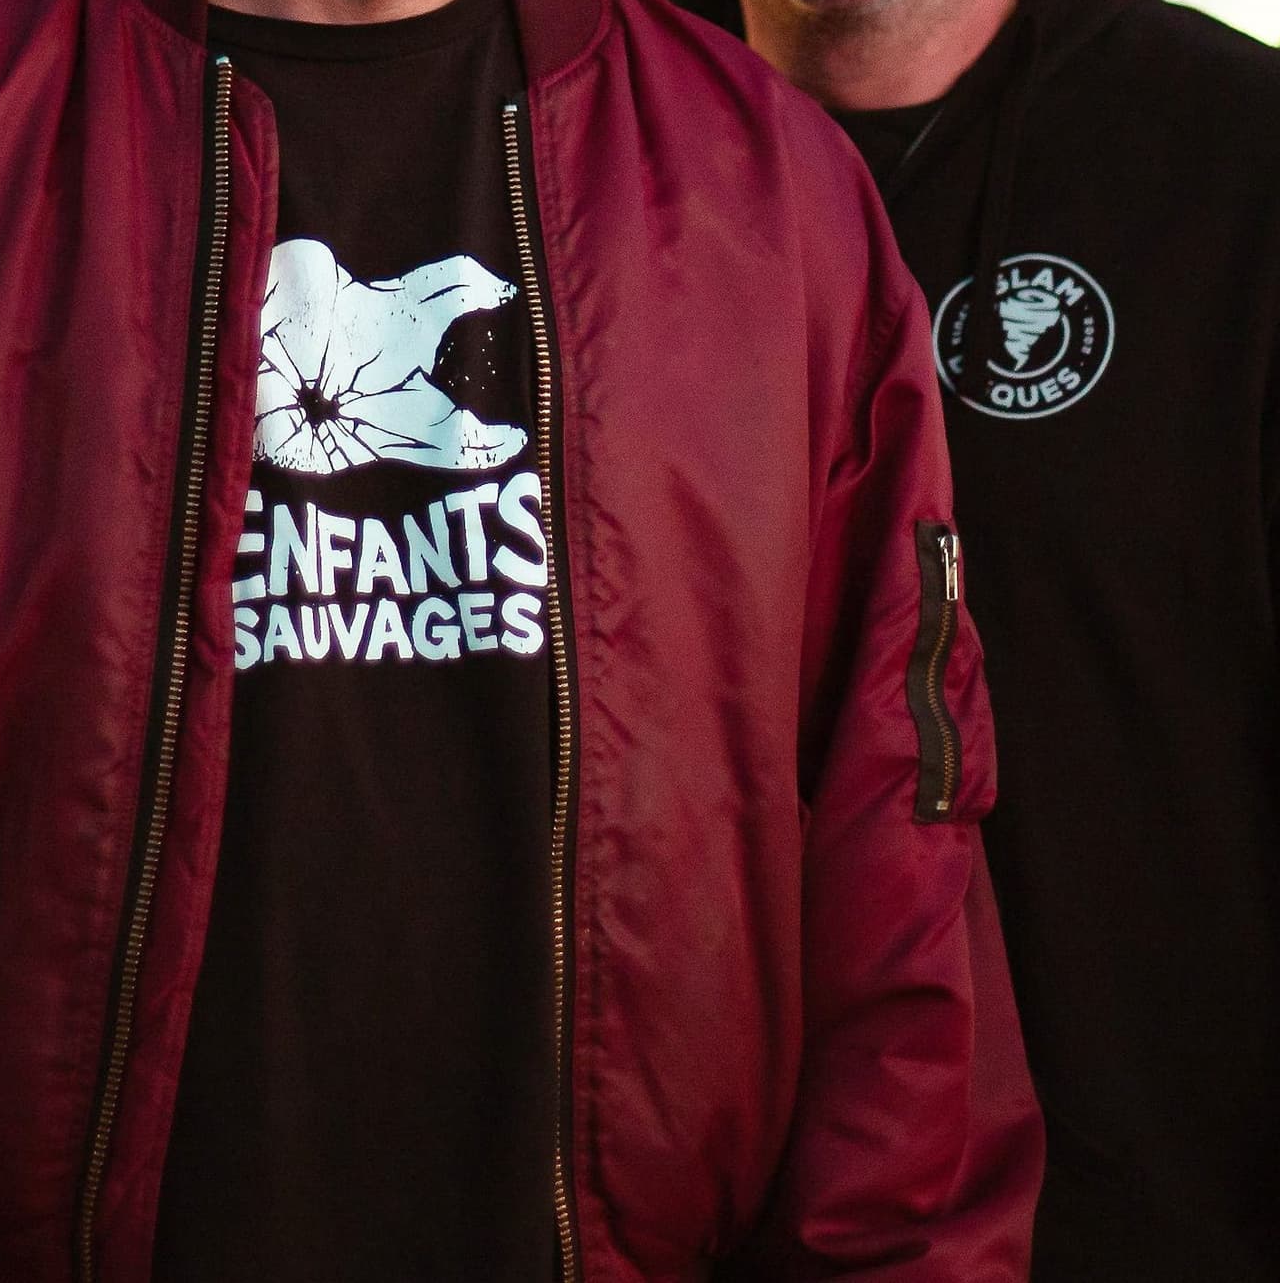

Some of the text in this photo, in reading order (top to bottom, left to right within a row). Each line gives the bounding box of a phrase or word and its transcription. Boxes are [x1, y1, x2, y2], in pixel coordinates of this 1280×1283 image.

[995, 267, 1085, 307] SLAM
[232, 472, 548, 602] ENFANTS
[234, 592, 544, 671] SAUVAGES
